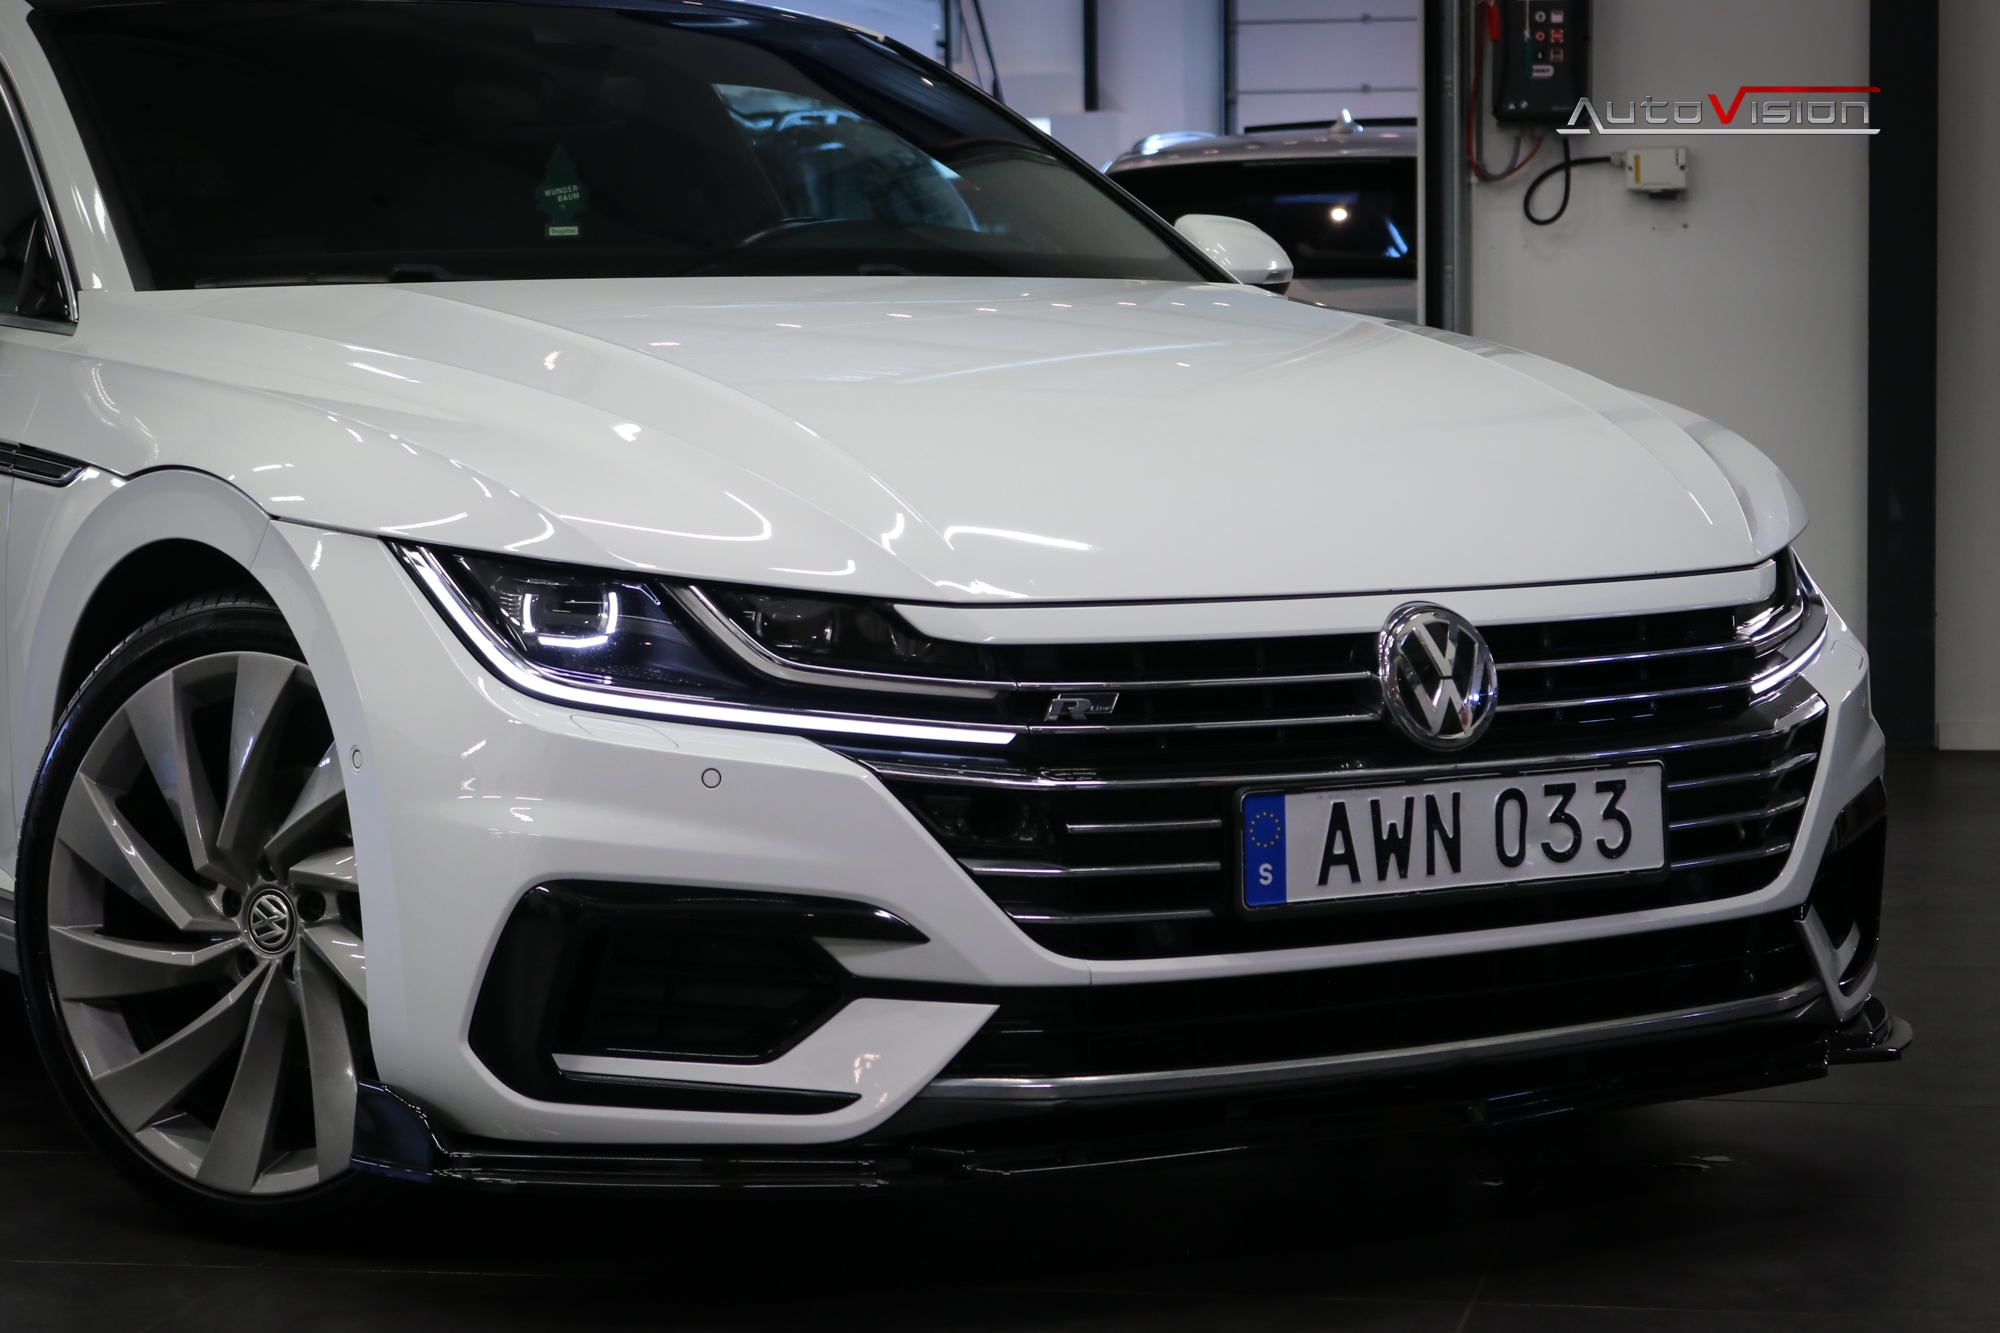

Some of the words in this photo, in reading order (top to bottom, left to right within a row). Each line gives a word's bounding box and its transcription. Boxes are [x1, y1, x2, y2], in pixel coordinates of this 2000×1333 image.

[557, 192, 580, 202] BAUM
[1044, 698, 1091, 721] R
[1317, 791, 1461, 887] AWN
[1494, 779, 1632, 869] 033
[1258, 863, 1274, 887] S
